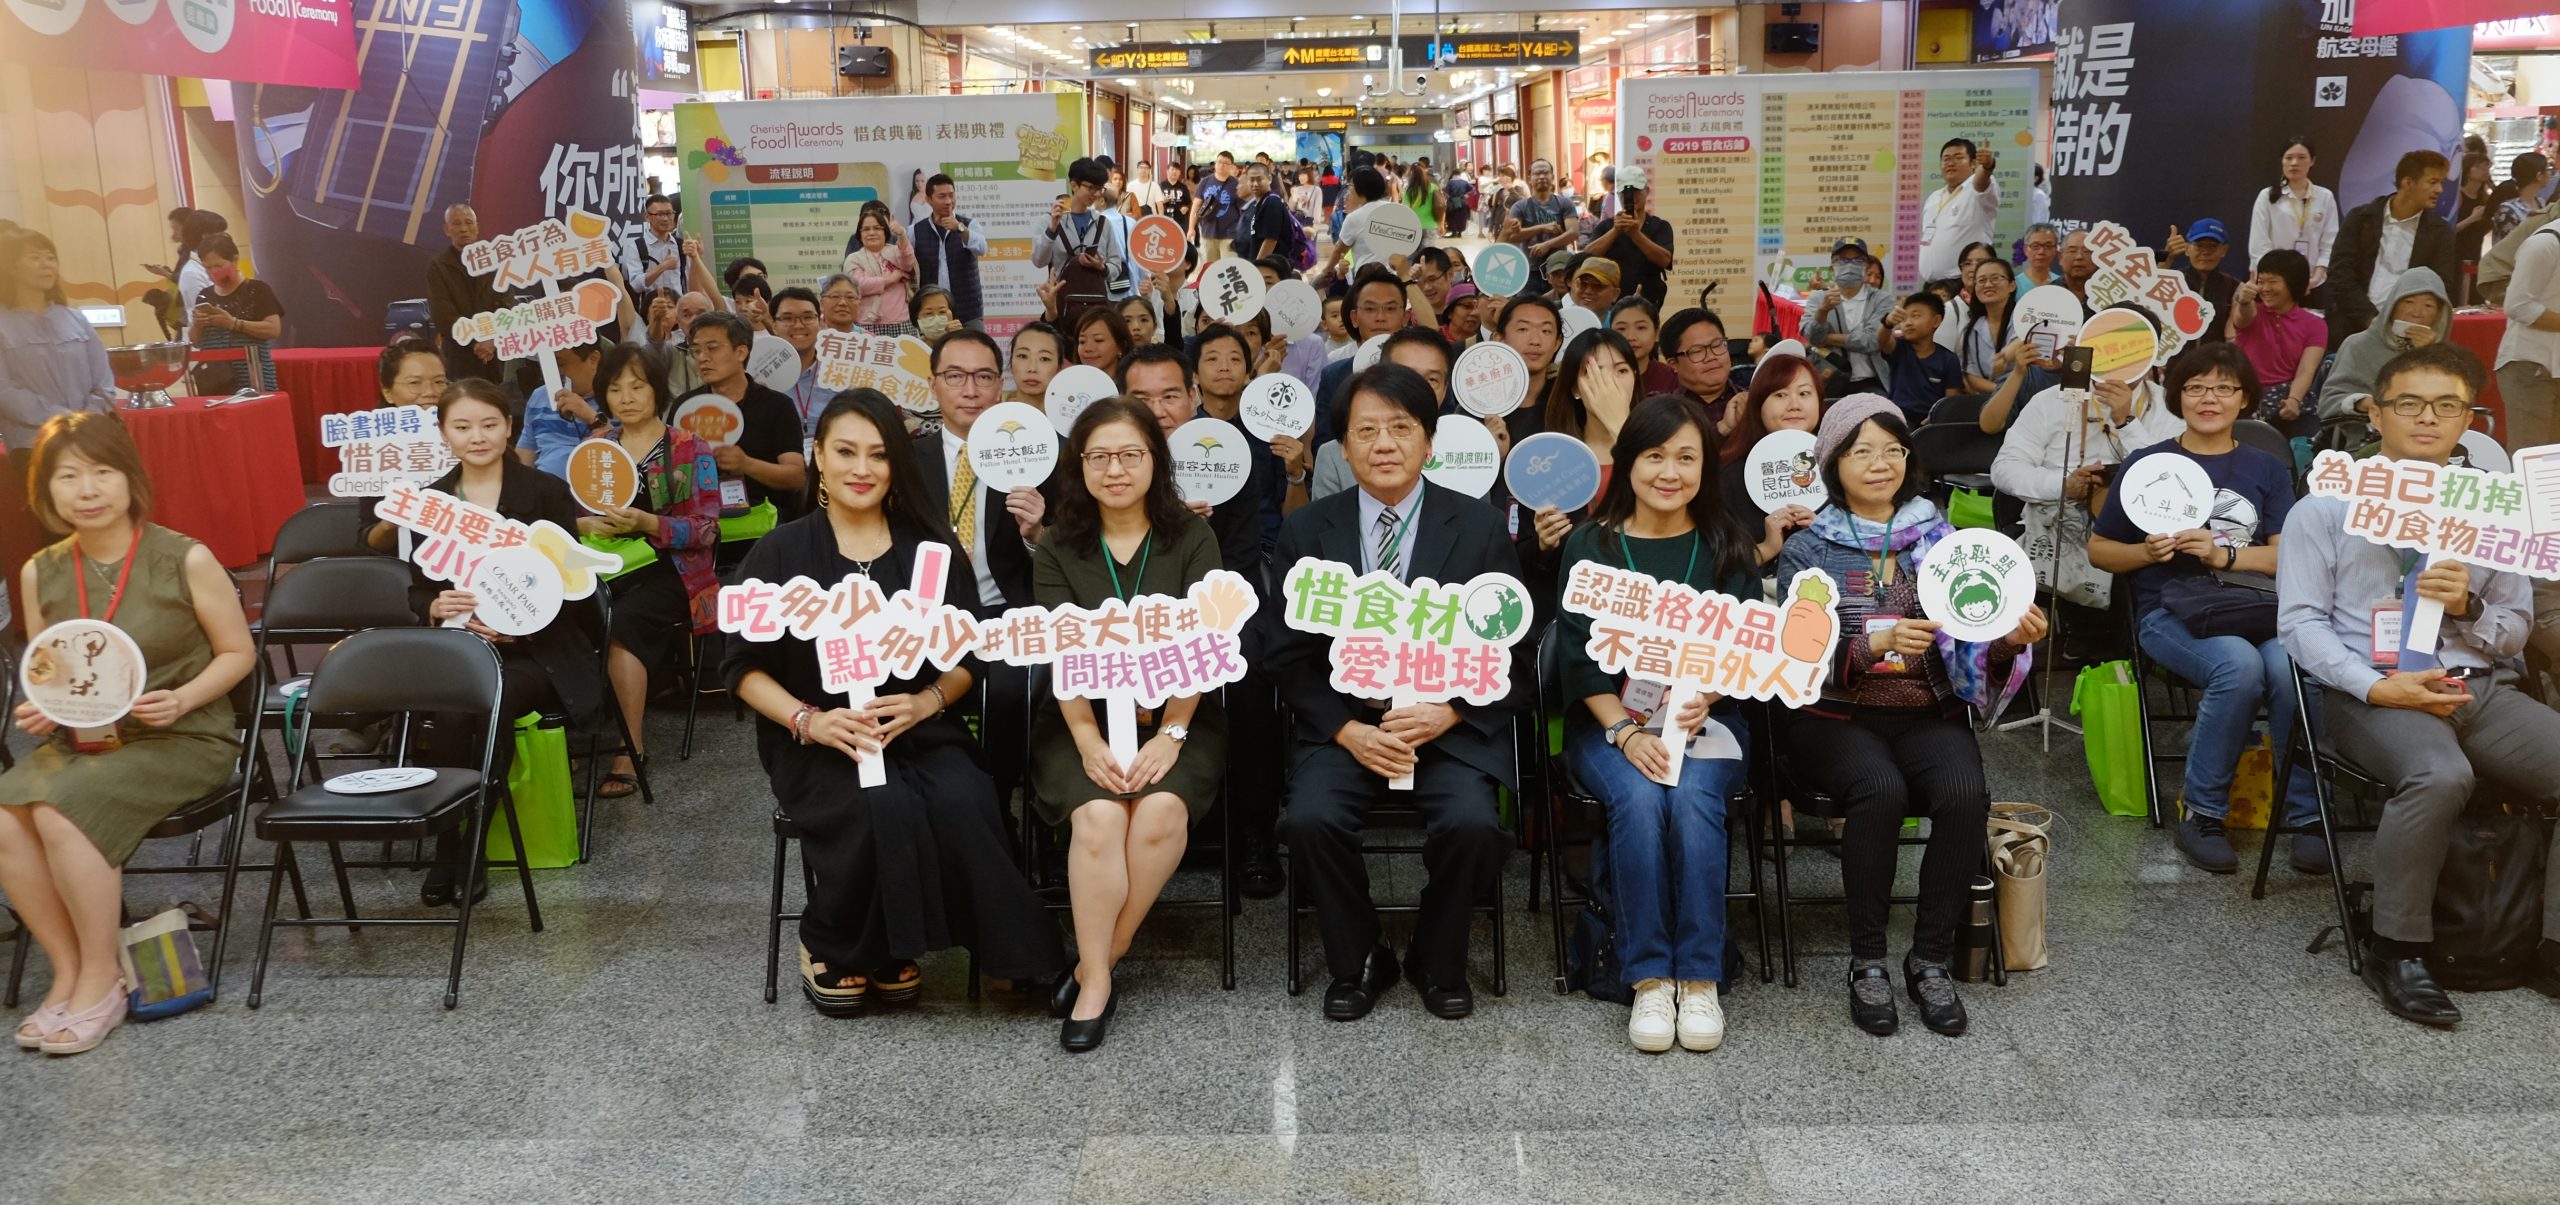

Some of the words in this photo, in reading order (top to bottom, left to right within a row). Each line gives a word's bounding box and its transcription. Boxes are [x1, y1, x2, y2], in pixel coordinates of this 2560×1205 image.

[296, 2, 338, 26] Ceremony
[1125, 53, 1147, 68] Y3
[1300, 49, 1315, 63] M
[1522, 42, 1544, 57] Y4
[1648, 94, 1685, 104] Cherish
[1687, 91, 1745, 118] Awards
[1648, 106, 1685, 119] Food
[1698, 108, 1744, 118] Ceremony
[750, 124, 786, 134] Cherish
[787, 122, 844, 148] Awards
[854, 124, 923, 142] 惜食典範
[935, 121, 1005, 139] 表揚典禮
[1494, 123, 1519, 132] MIKI
[1648, 122, 1691, 133] 惜食典範
[1701, 121, 1743, 132] 表揚典禮
[751, 136, 787, 149] Food
[799, 139, 844, 148] Ceremony
[1670, 142, 1699, 151] 2019
[769, 168, 814, 179] 流程說明
[466, 221, 568, 272] 惜食行為
[497, 239, 609, 288] 人人有責
[1800, 270, 1828, 280] 208
[2091, 226, 2184, 311] 吃全食
[456, 296, 576, 339] 少量多次購買
[498, 319, 593, 358] 減少浪費
[821, 333, 897, 367] 有計畫
[978, 443, 1048, 461] 福容大飯店
[979, 461, 1001, 469] Fullon
[1003, 458, 1021, 466] Hotel
[1023, 455, 1050, 464] Taoyuan
[1445, 451, 1494, 466] 西湖渡假村
[1173, 460, 1240, 474] 福容大飯店
[333, 475, 389, 493] Cherish
[1763, 485, 1821, 500] HOMELANIE
[2314, 456, 2525, 517] 為自己扔掉
[382, 486, 530, 550] 主動要求
[2351, 499, 2560, 574] 的食物記帳
[1928, 544, 2017, 583] 主婦聯盟
[517, 593, 541, 617] PARK
[1293, 567, 1462, 646] 惜食材
[1570, 567, 1779, 655] 認識格外品
[983, 602, 1198, 658] #惜食大使#
[823, 612, 979, 686] 點多少
[1061, 632, 1238, 700] 問我問我
[1338, 636, 1502, 694] 愛地球
